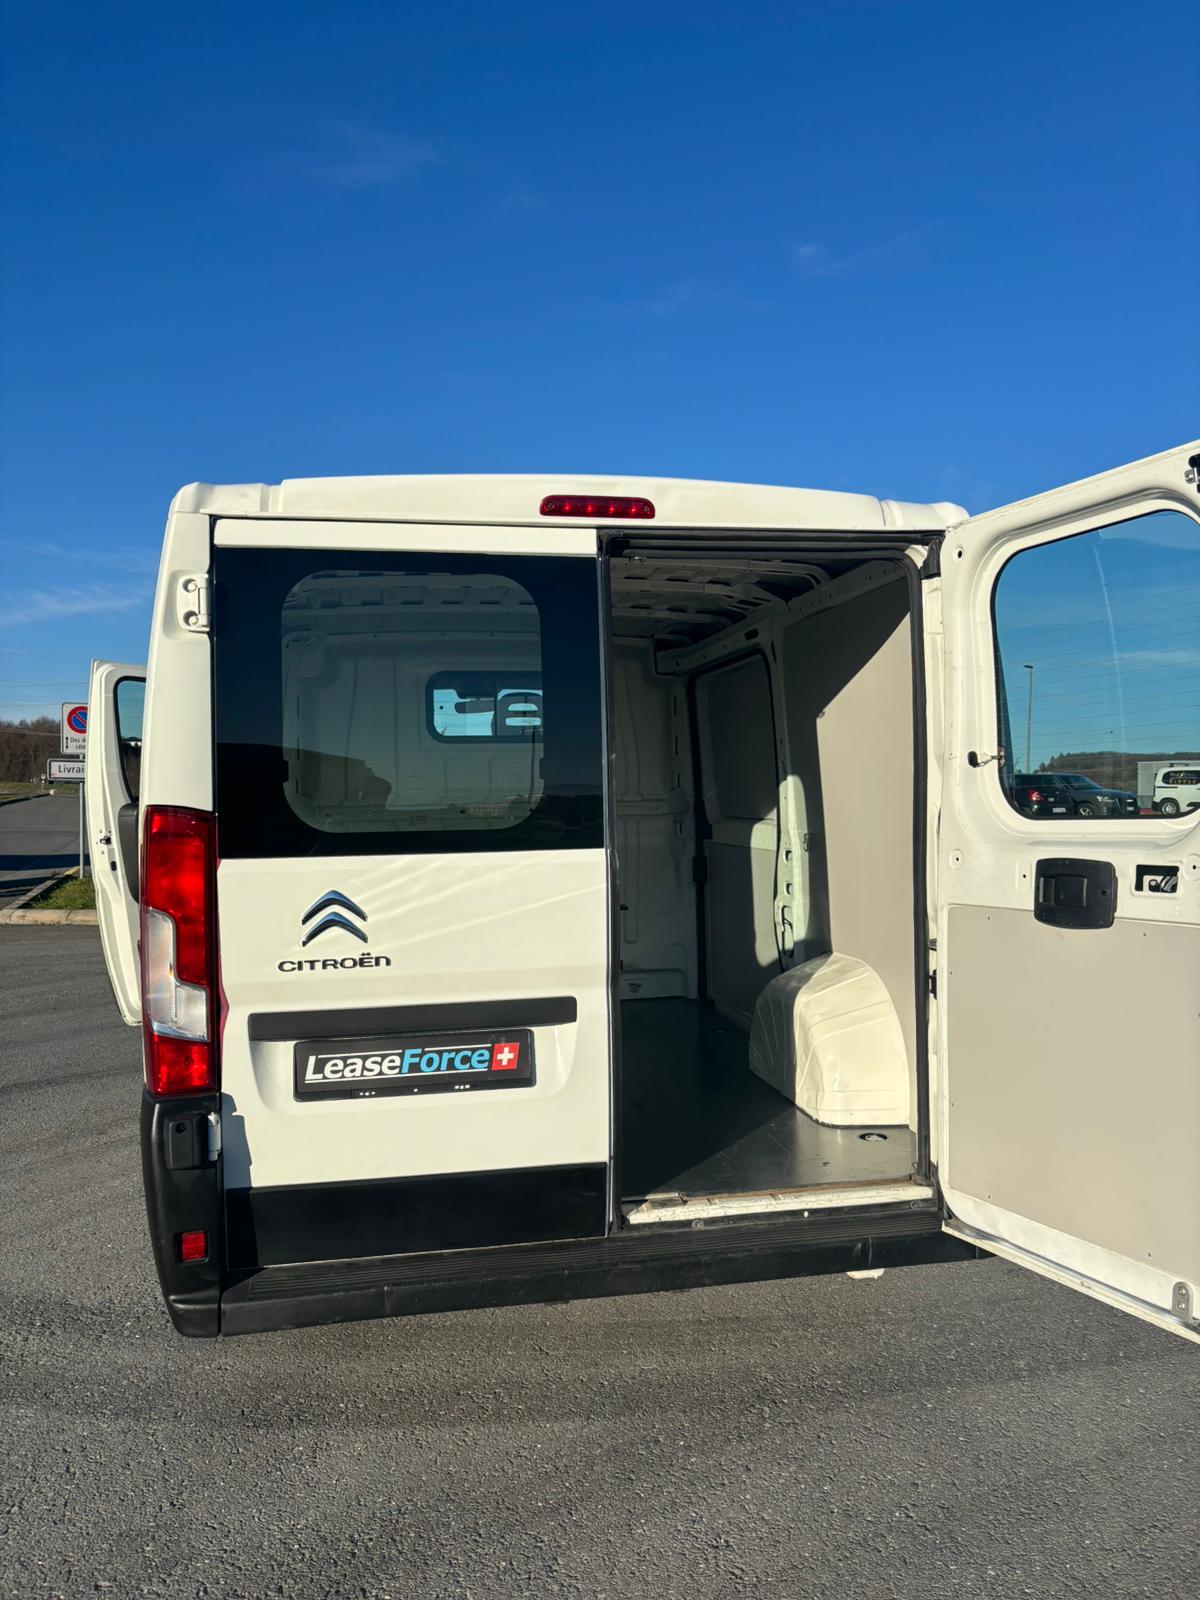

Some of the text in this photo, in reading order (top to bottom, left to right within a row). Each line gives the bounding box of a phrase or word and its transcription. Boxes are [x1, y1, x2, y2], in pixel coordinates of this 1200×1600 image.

[58, 765, 85, 774] Livrai
[277, 952, 391, 972] CITROËN
[304, 1048, 490, 1080] LeaseForce
